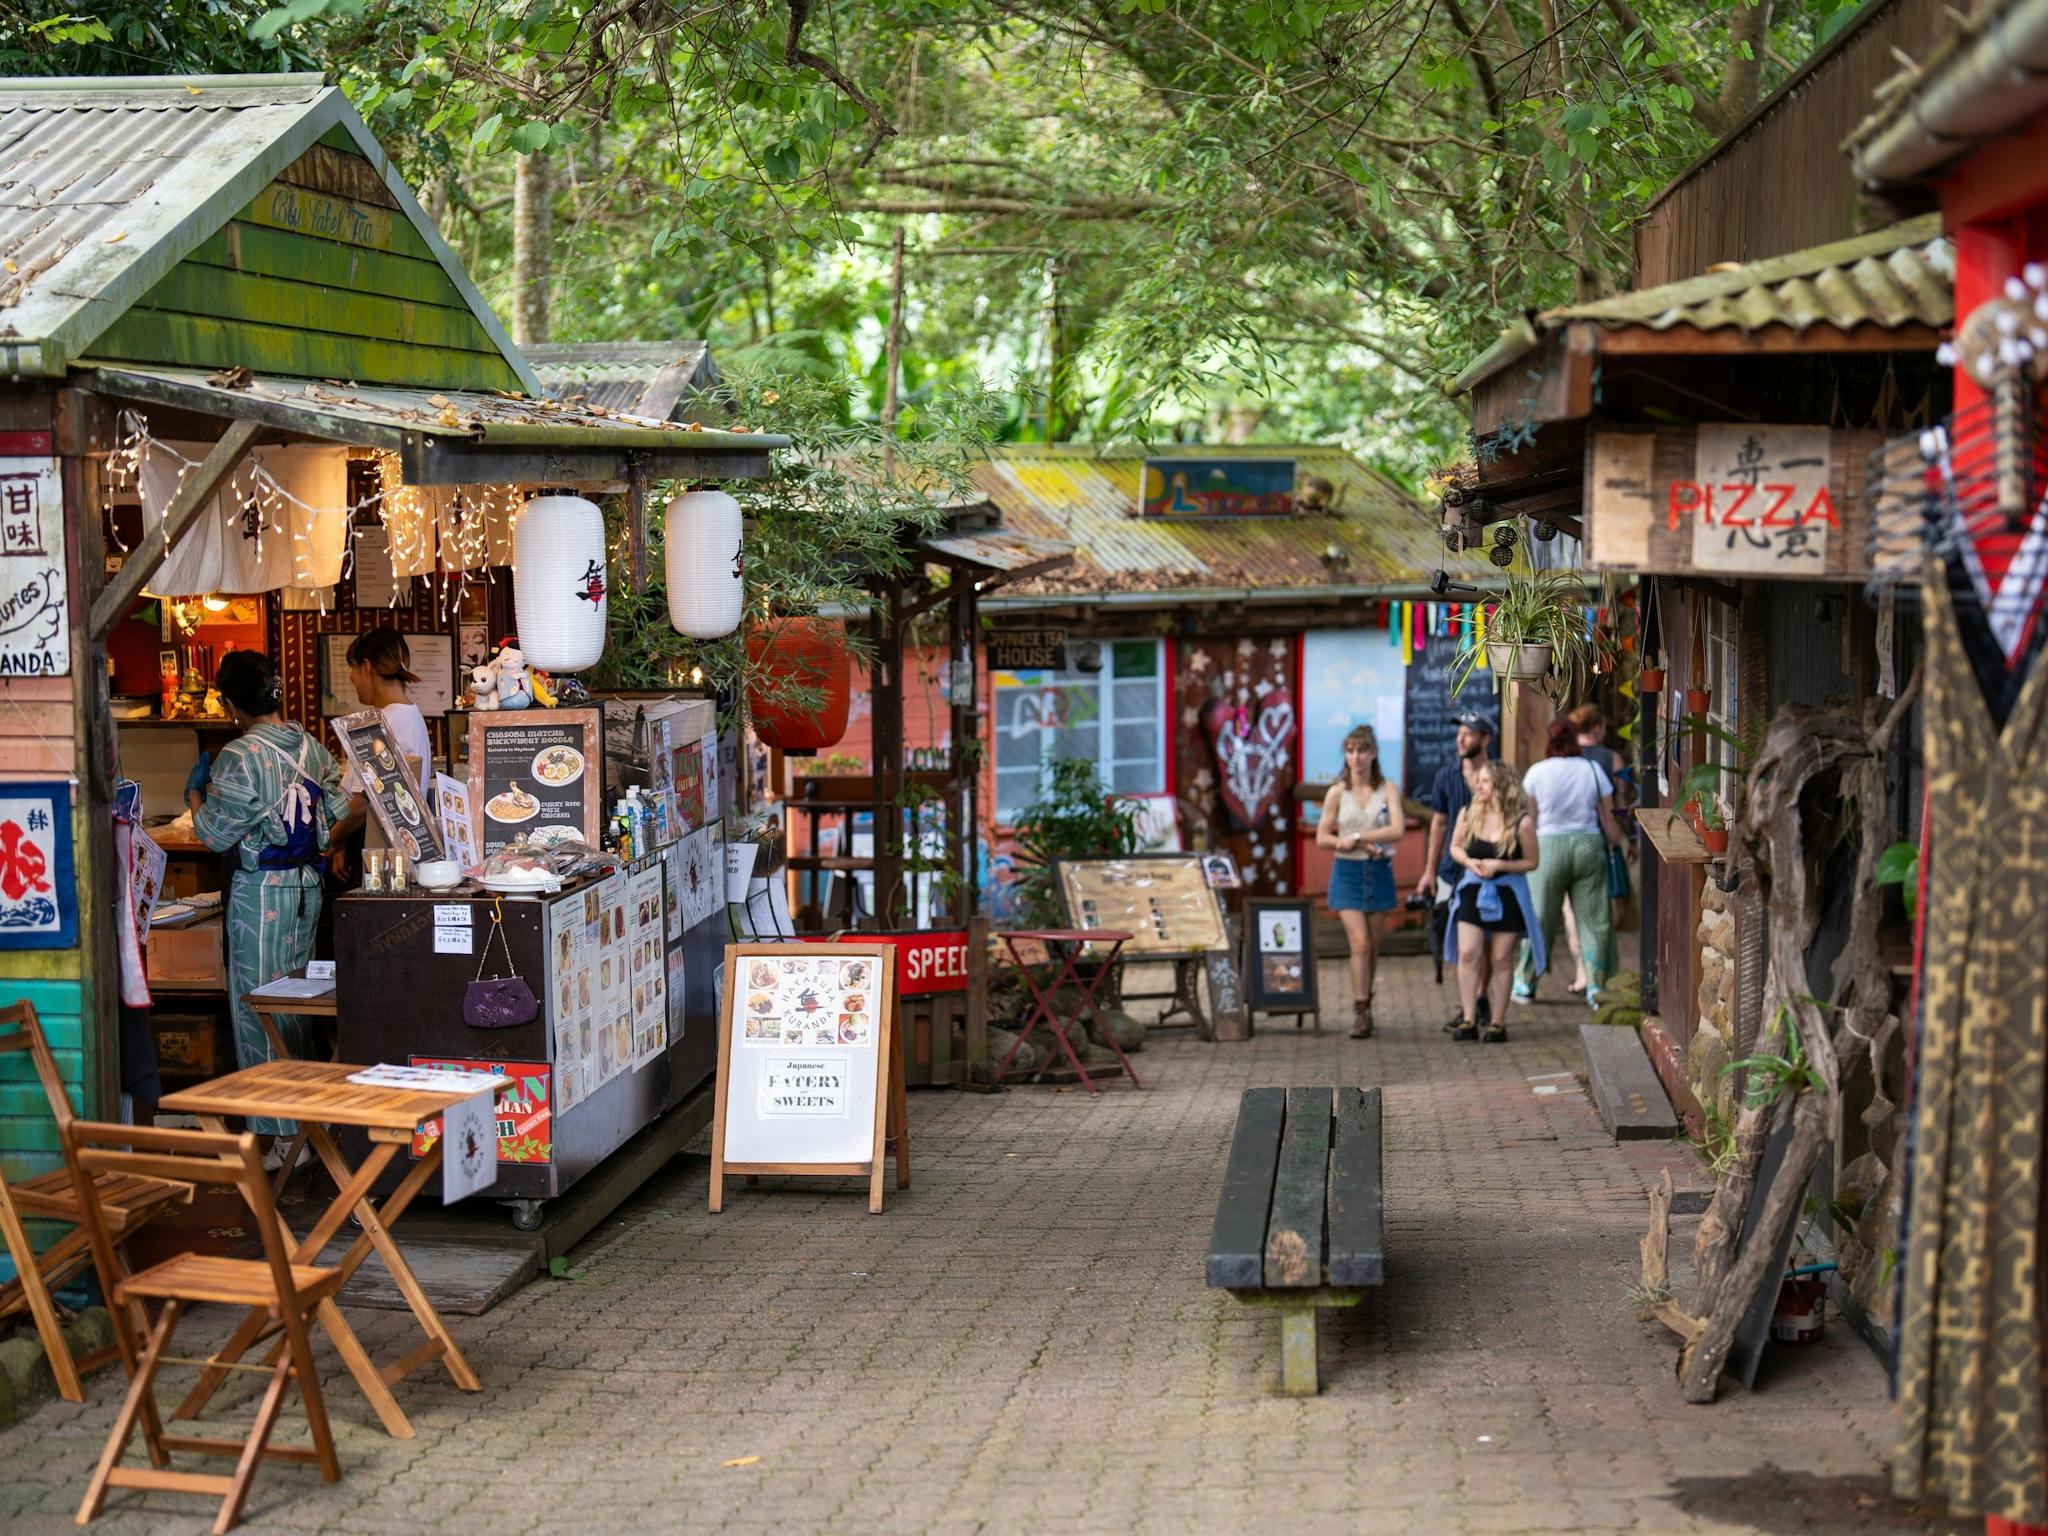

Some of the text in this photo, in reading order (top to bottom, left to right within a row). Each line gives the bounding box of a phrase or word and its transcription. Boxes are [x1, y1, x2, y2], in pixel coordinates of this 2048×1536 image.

[1667, 480, 1841, 532] PIZZA
[997, 647, 1056, 666] HOUSE
[782, 975, 836, 1003] HAYABUSA
[783, 1009, 834, 1031] KURANDA
[786, 1062, 825, 1071] Japanese
[774, 1096, 834, 1107] SWEETS
